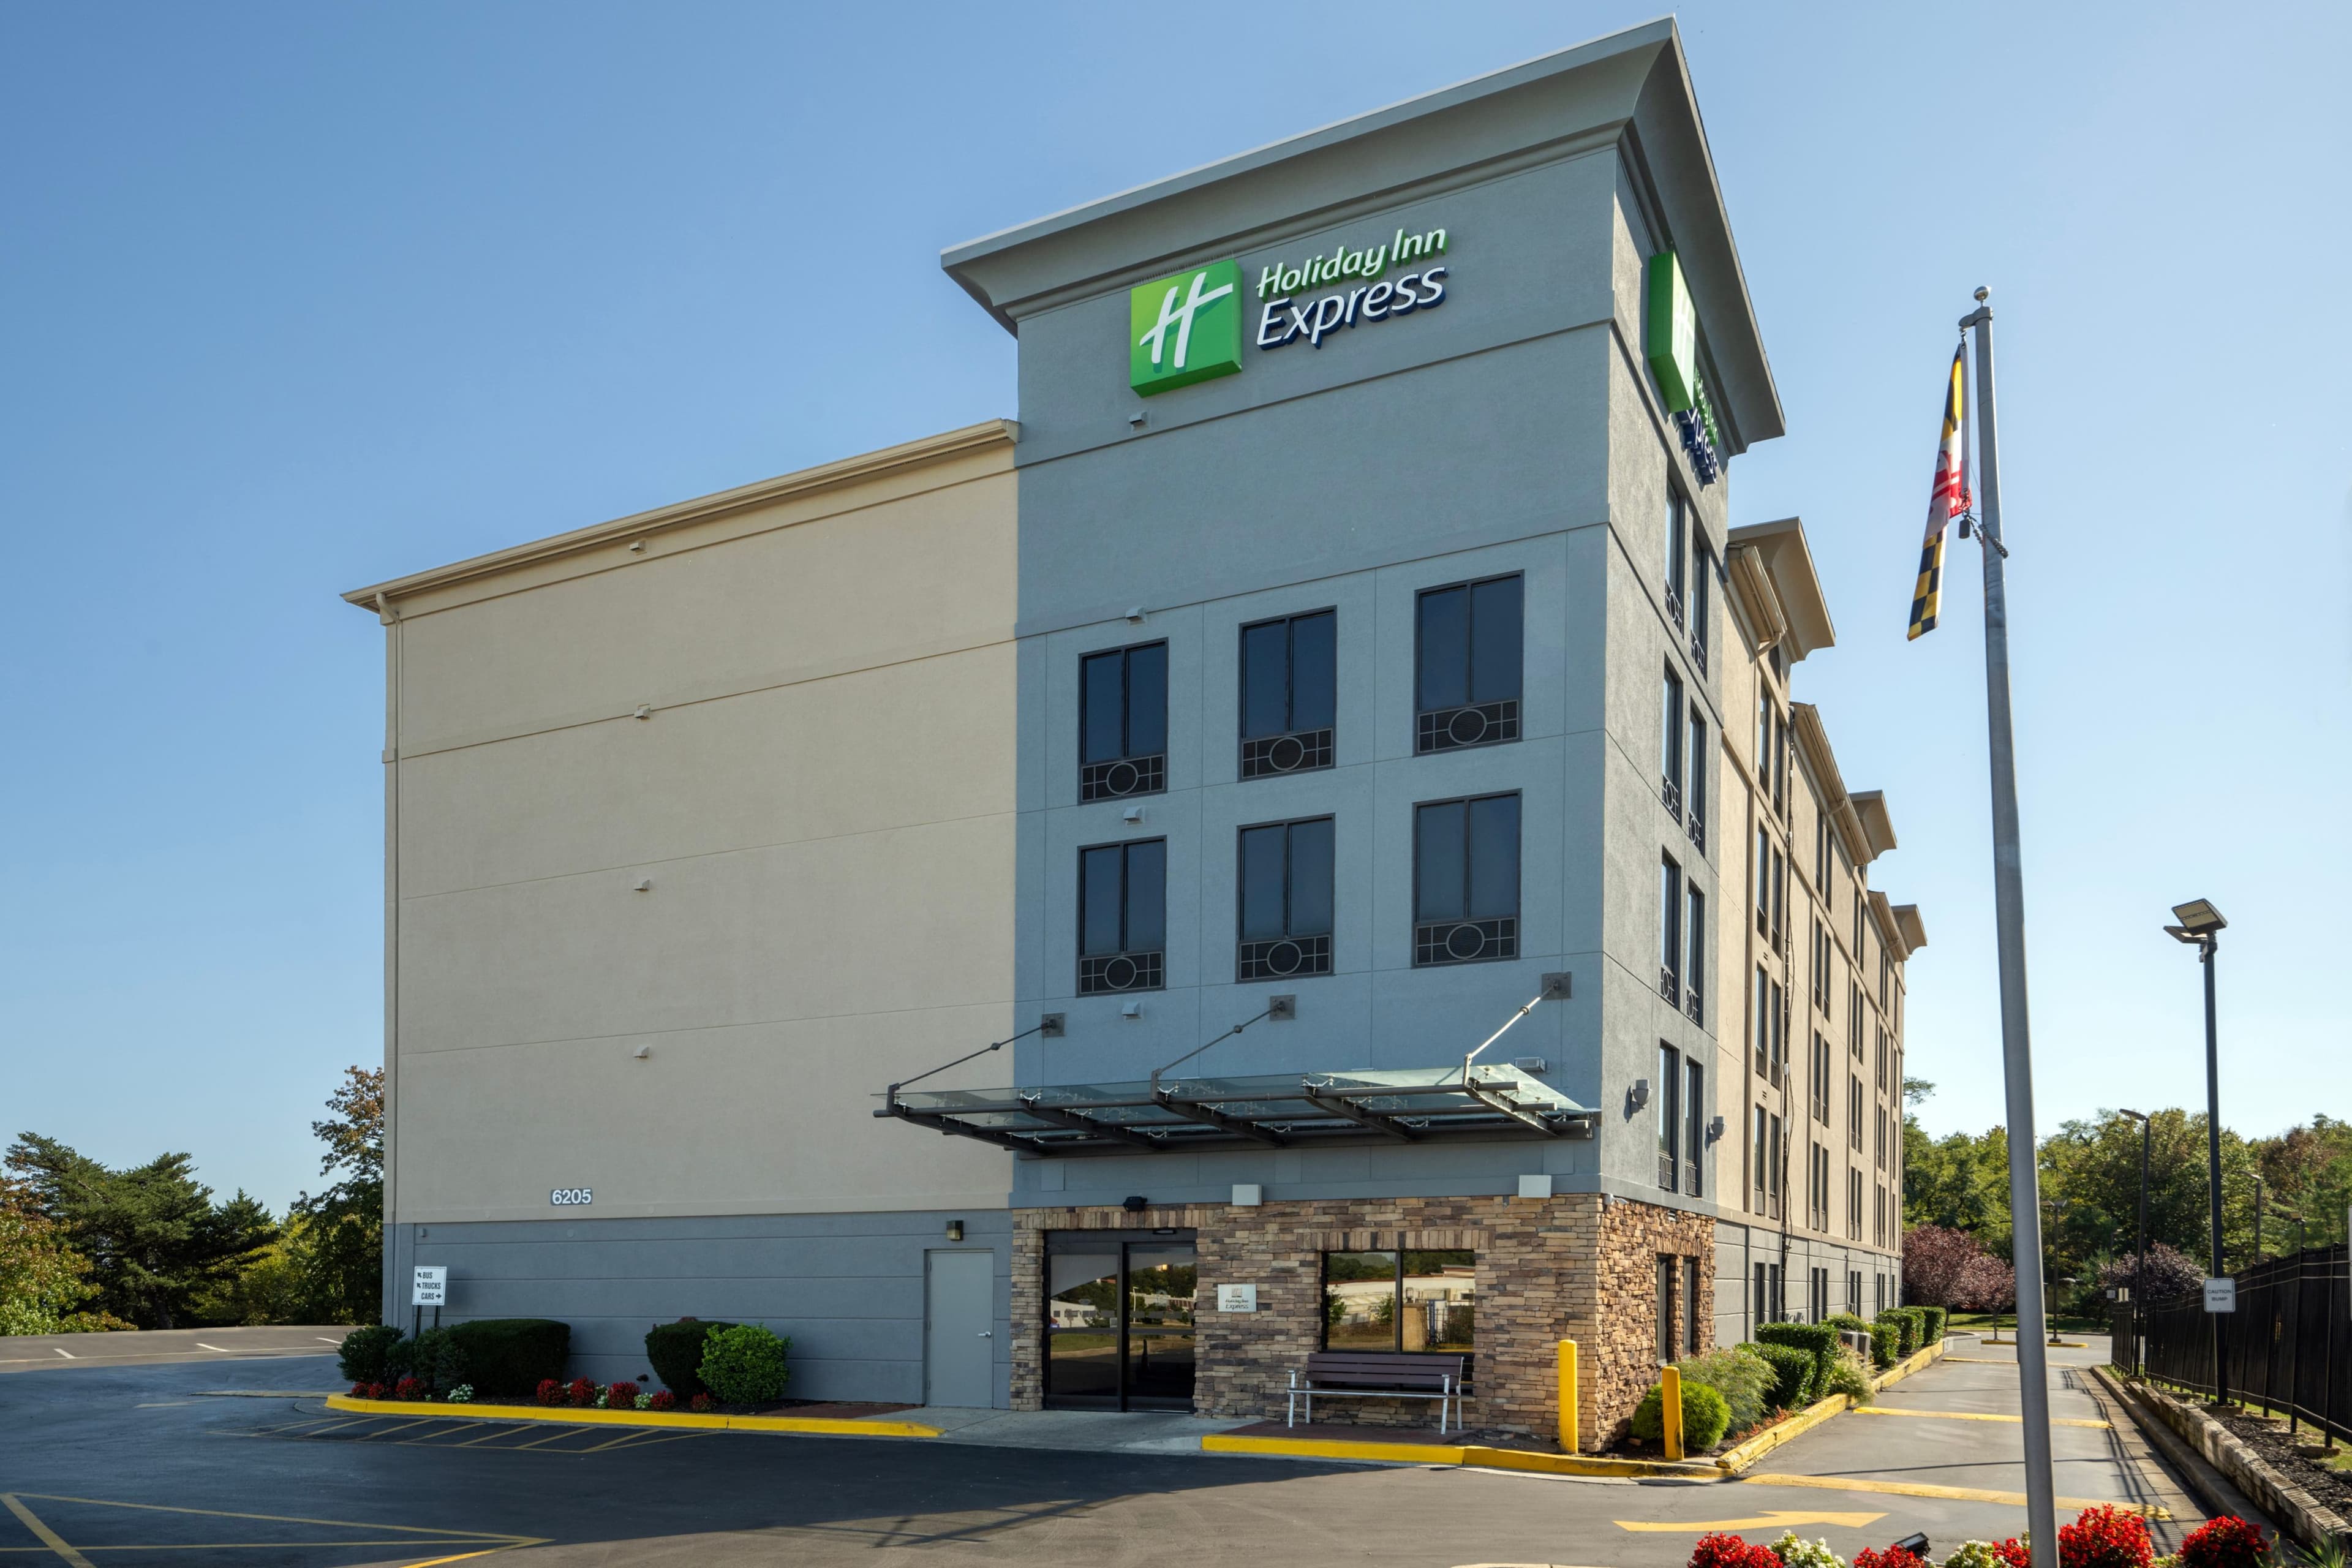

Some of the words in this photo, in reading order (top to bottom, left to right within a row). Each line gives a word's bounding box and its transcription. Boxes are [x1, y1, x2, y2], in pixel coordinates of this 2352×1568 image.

[1256, 245, 1388, 303] Holiday
[1392, 228, 1449, 267] Inn
[1257, 267, 1448, 349] Express
[552, 1189, 592, 1205] 6205
